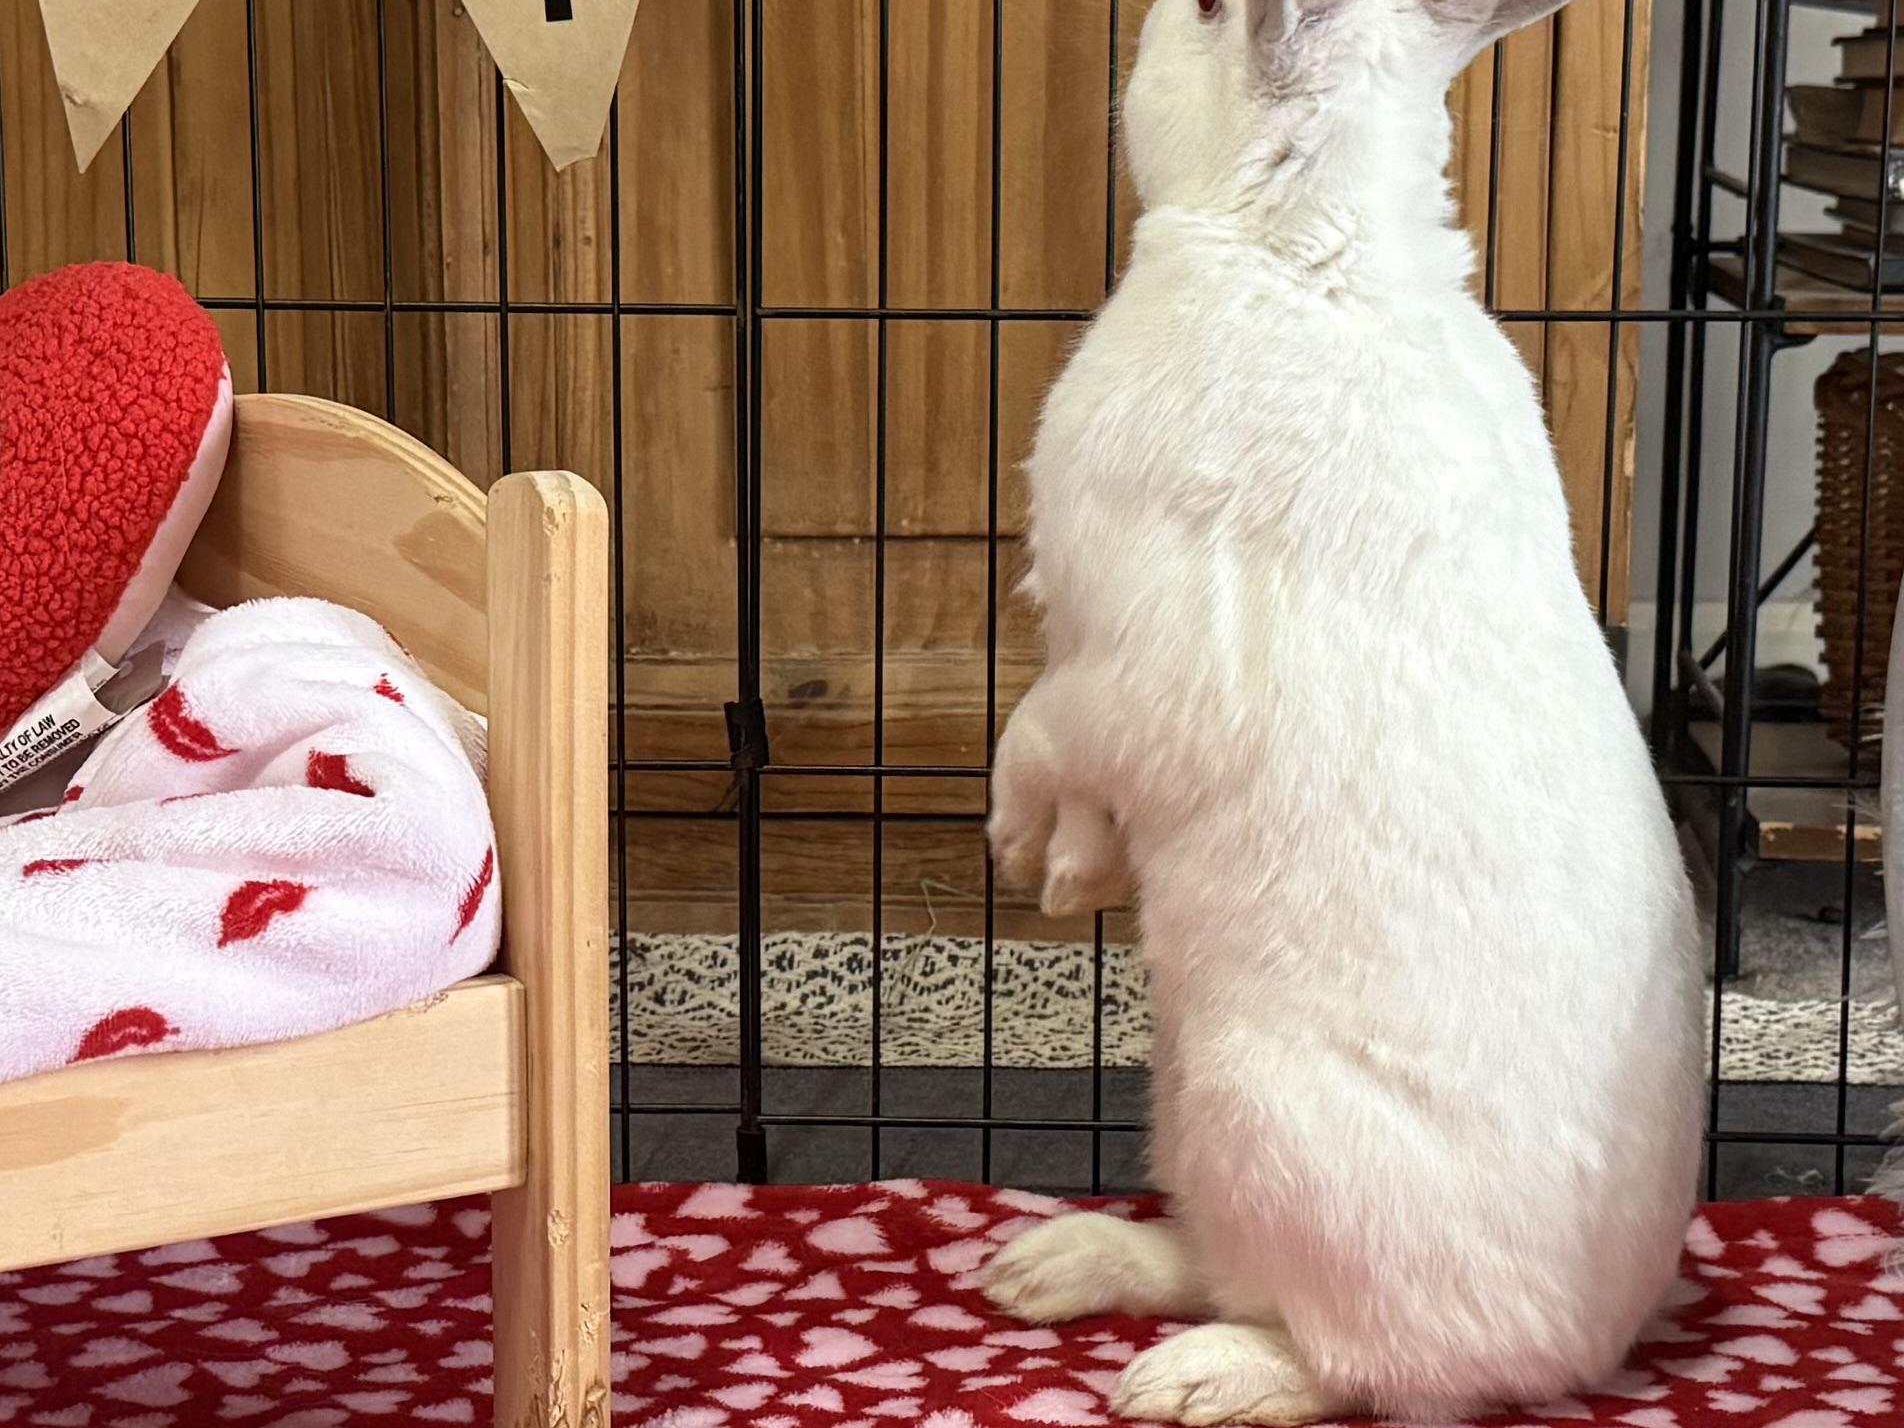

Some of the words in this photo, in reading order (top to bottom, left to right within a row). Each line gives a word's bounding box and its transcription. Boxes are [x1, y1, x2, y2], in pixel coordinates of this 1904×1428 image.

[2, 760, 19, 774] TO
[17, 749, 34, 763] BE
[32, 718, 81, 754] REMOVED
[17, 730, 33, 746] OF
[31, 714, 56, 736] LAW
